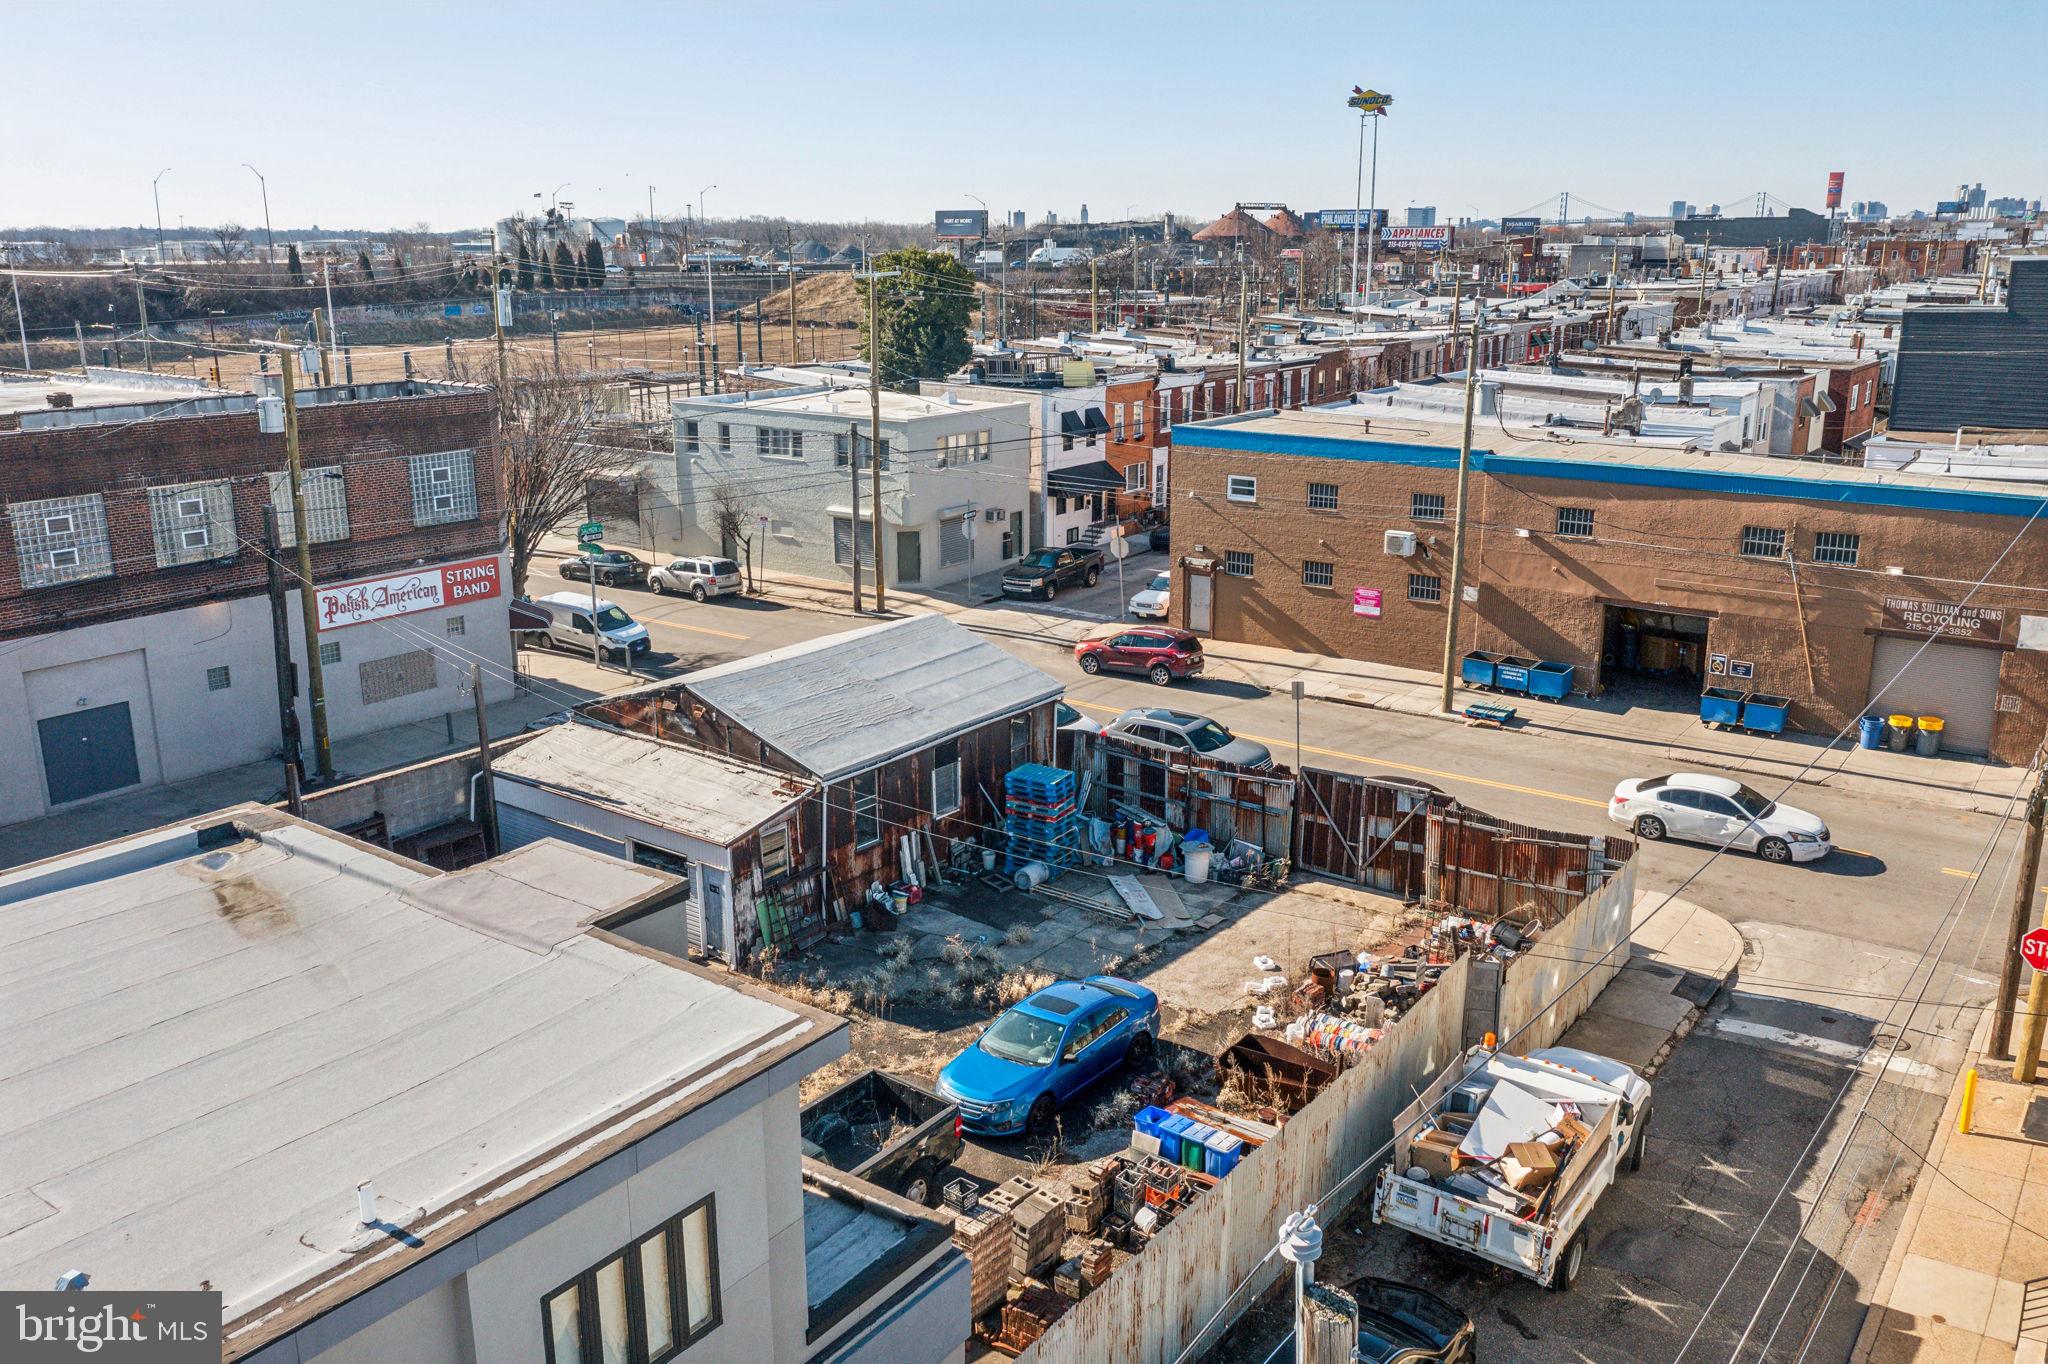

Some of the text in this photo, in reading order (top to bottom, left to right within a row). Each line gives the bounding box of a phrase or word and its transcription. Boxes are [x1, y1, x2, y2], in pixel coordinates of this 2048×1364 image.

[1350, 95, 1389, 106] SUNOCO
[1321, 214, 1368, 224] PHILAWDELHIA
[1392, 228, 1446, 238] APPLIANCES
[446, 565, 496, 584] STRING
[453, 581, 490, 598] BAND
[323, 577, 440, 623] Polish American
[1886, 599, 2002, 621] THOMAS SULLIVAN and SONS
[1904, 611, 1981, 629] RECYCLING
[2025, 938, 2048, 957] ST
